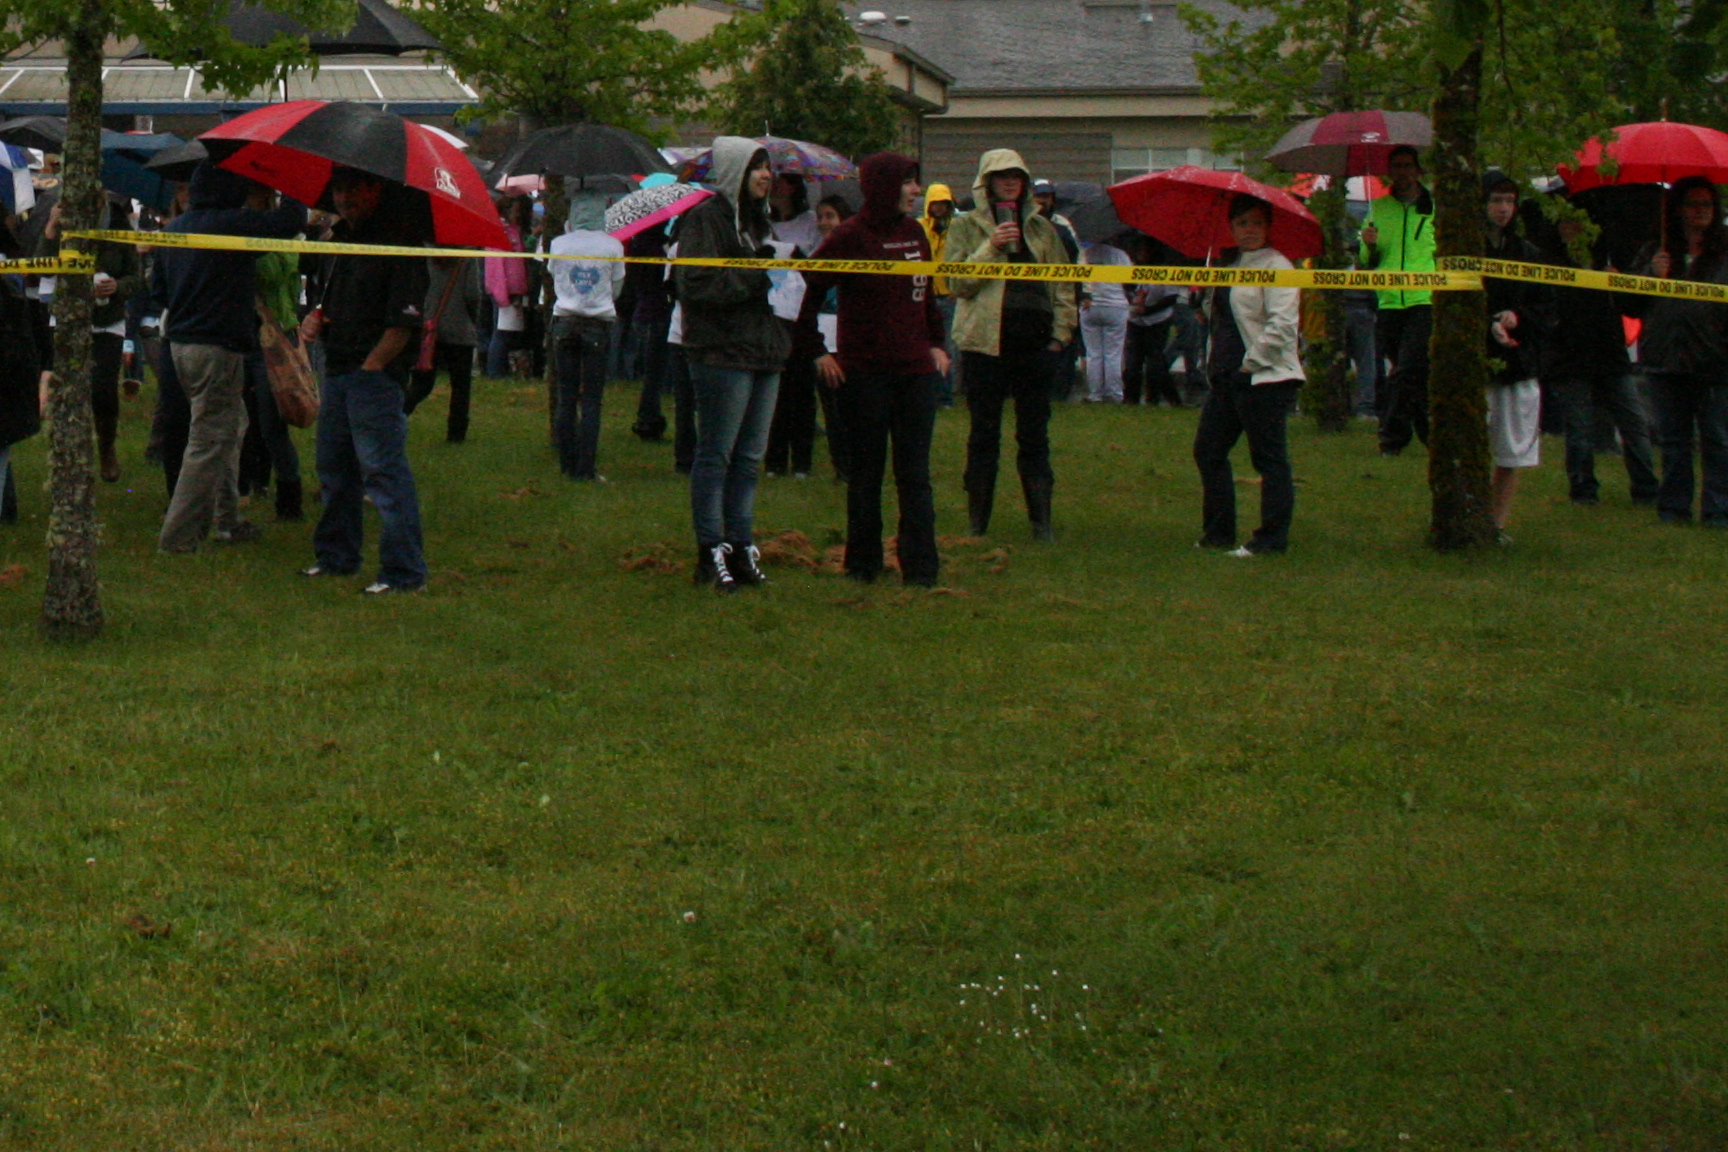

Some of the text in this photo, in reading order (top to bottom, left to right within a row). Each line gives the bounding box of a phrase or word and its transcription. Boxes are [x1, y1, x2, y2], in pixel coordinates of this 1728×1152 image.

[935, 263, 1093, 278] POLICE LINE DO NOT CROSS
[1442, 258, 1482, 272] CROSS
[1506, 263, 1519, 276] DO
[1521, 264, 1541, 278] LINE
[1131, 268, 1276, 283] POLICE LINE DO NOT CROSS
[1313, 271, 1447, 286] POLICE LINE DO NOT CROSS
[1545, 266, 1576, 282] POLICE
[1659, 280, 1671, 293] DO
[1695, 283, 1725, 297] POLICE
